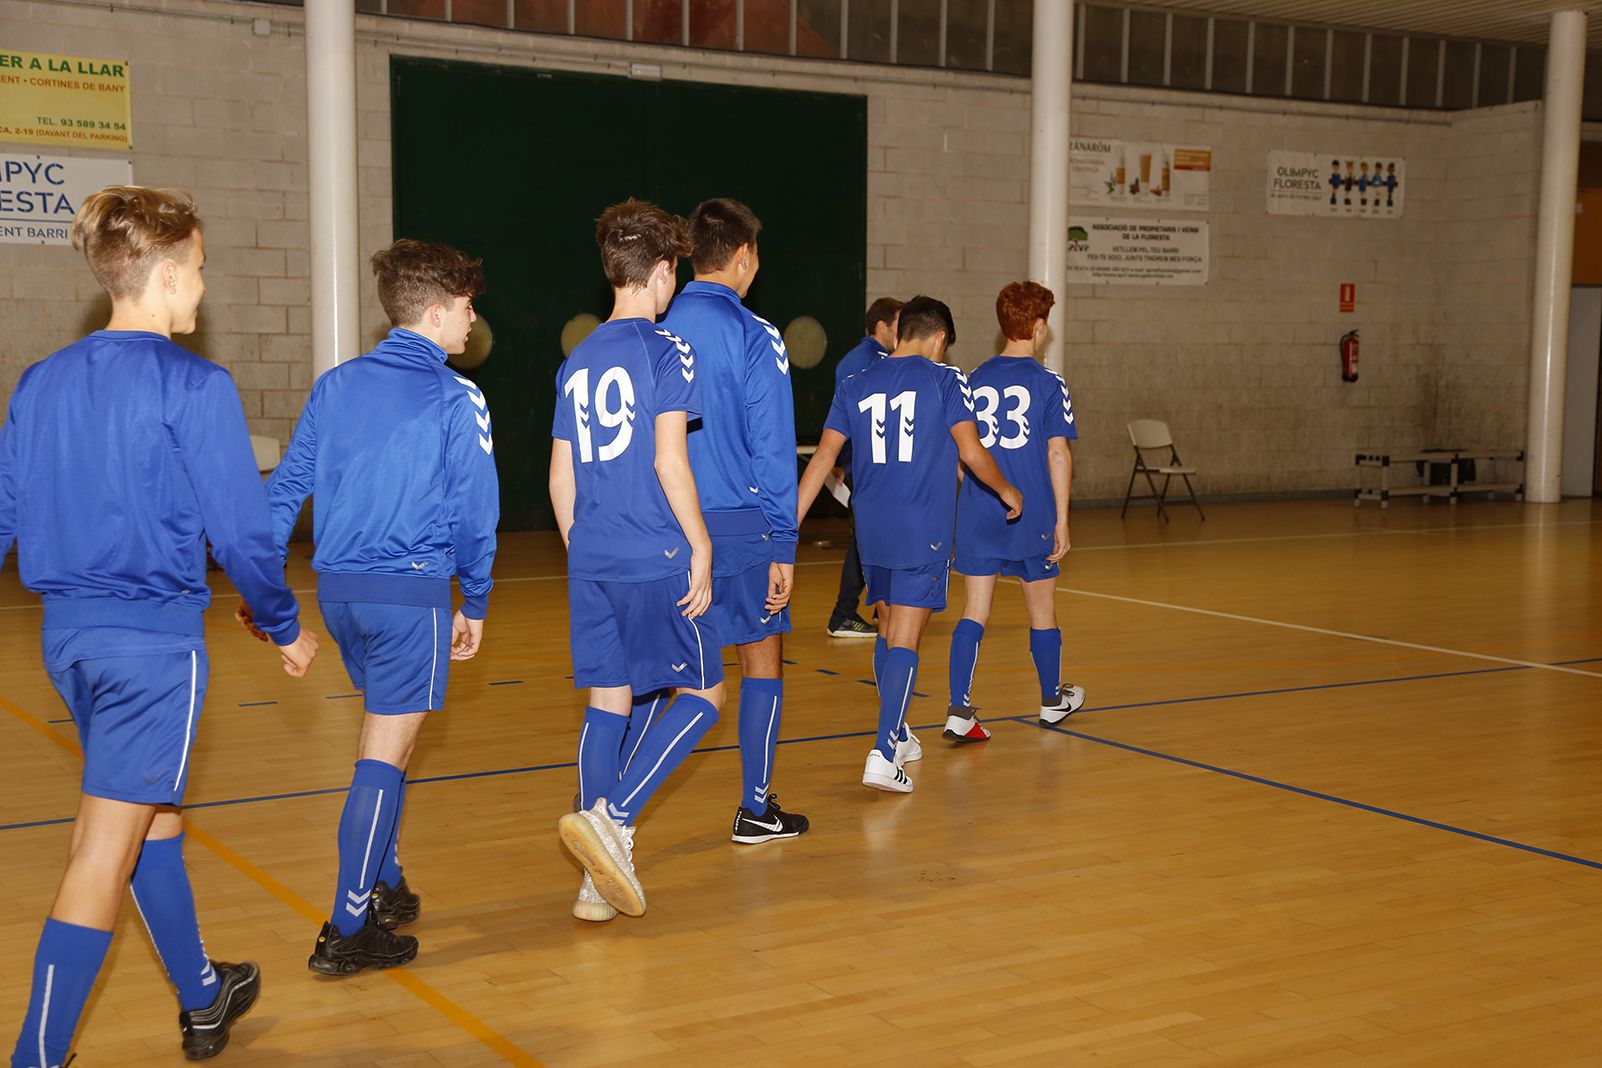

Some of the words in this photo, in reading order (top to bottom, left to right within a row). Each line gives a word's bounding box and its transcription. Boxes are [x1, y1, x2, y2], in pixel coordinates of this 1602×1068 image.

[0, 55, 23, 69] ER
[29, 57, 42, 70] A
[48, 59, 72, 73] LA
[78, 61, 125, 77] LLAR
[0, 75, 20, 84] ENT
[29, 77, 80, 89] CORTINES
[82, 82, 96, 91] DE
[98, 83, 125, 93] BANY
[36, 129, 70, 138] (DAVANT
[72, 131, 87, 139] DEL
[60, 118, 73, 127] 93
[77, 120, 95, 129] 589
[98, 121, 111, 129] 34
[114, 122, 126, 130] 54
[0, 160, 65, 185] PYC
[1277, 166, 1319, 178] OLIMPYC
[1273, 178, 1322, 190] FLORESTA
[0, 190, 76, 215] ESTA
[27, 227, 68, 239] BARRI
[564, 366, 636, 464] 19
[972, 385, 1031, 450] 33
[857, 391, 917, 464] 11
